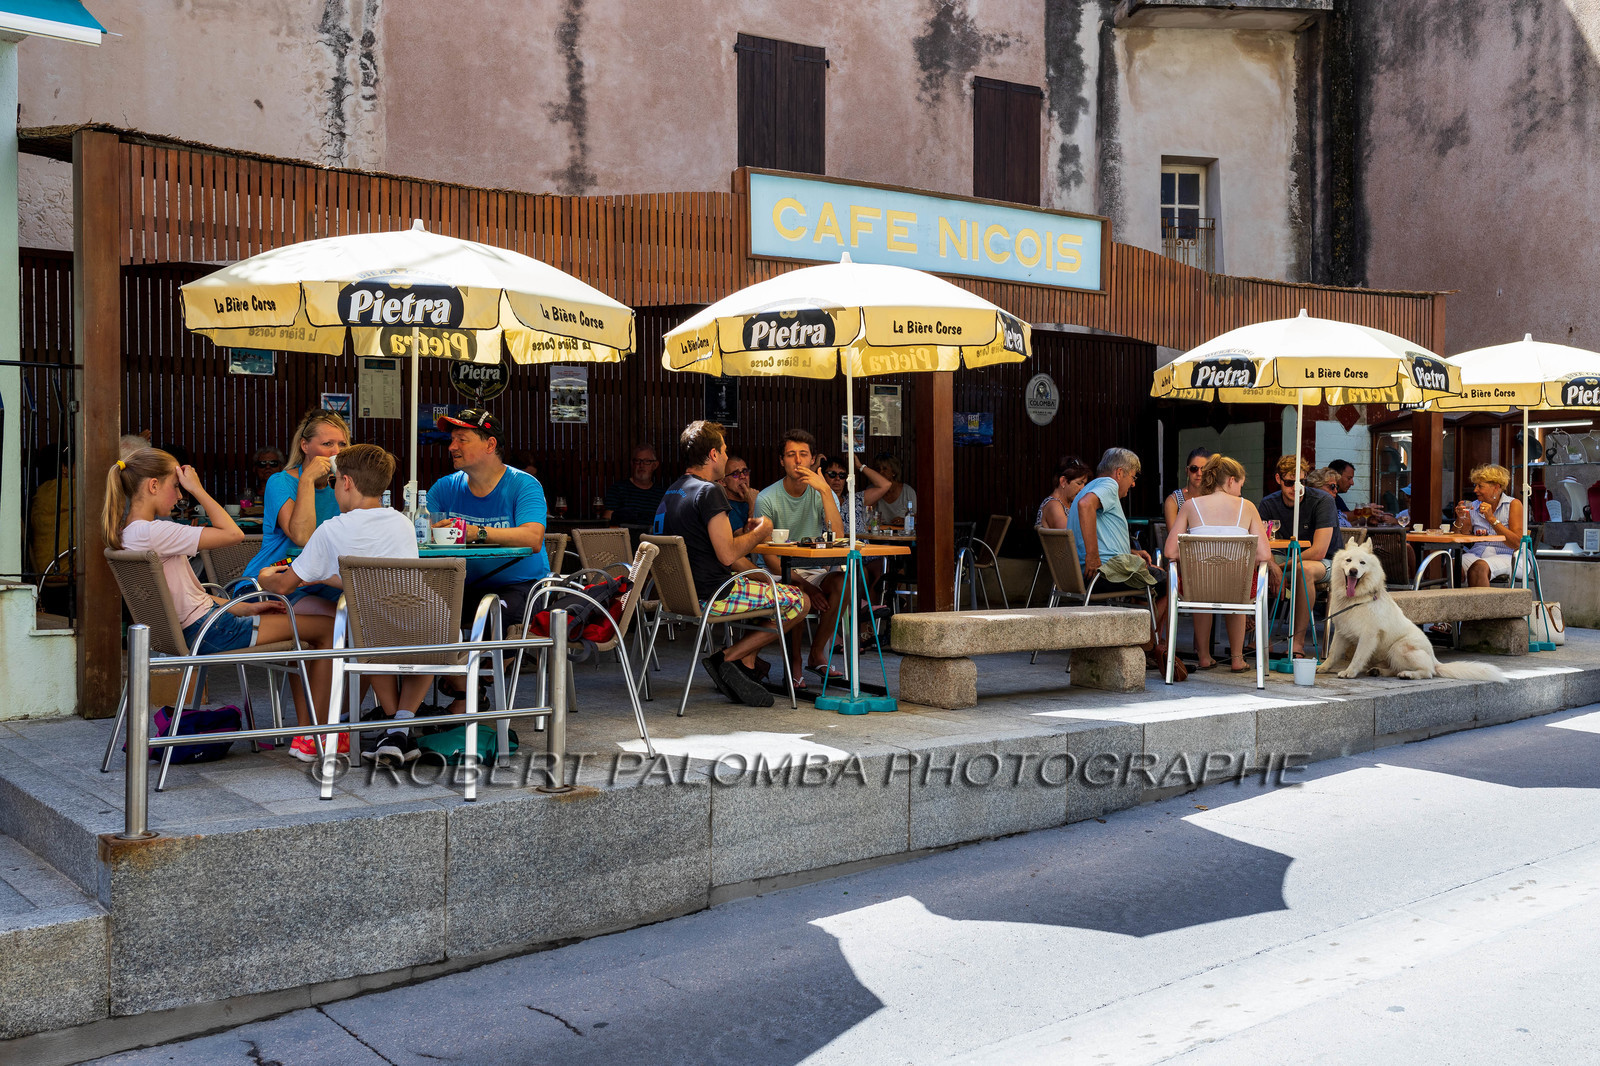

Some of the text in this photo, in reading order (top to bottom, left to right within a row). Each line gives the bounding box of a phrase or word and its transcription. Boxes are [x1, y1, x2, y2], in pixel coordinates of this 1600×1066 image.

[772, 197, 1083, 274] CAFE NICOIS
[213, 294, 276, 313] La Bière Corse
[347, 288, 452, 325] Pietra
[540, 303, 604, 330] La Bière Corse
[750, 320, 827, 350] Pietra
[893, 320, 962, 335] La Bière Corse
[459, 364, 500, 381] Pietra
[1195, 366, 1250, 387] Pietra
[1305, 367, 1369, 379] La Bière Corse
[1415, 366, 1446, 390] Pietra
[1471, 389, 1492, 399] Bière
[1494, 388, 1516, 398] Corse
[1567, 385, 1600, 405] Piet
